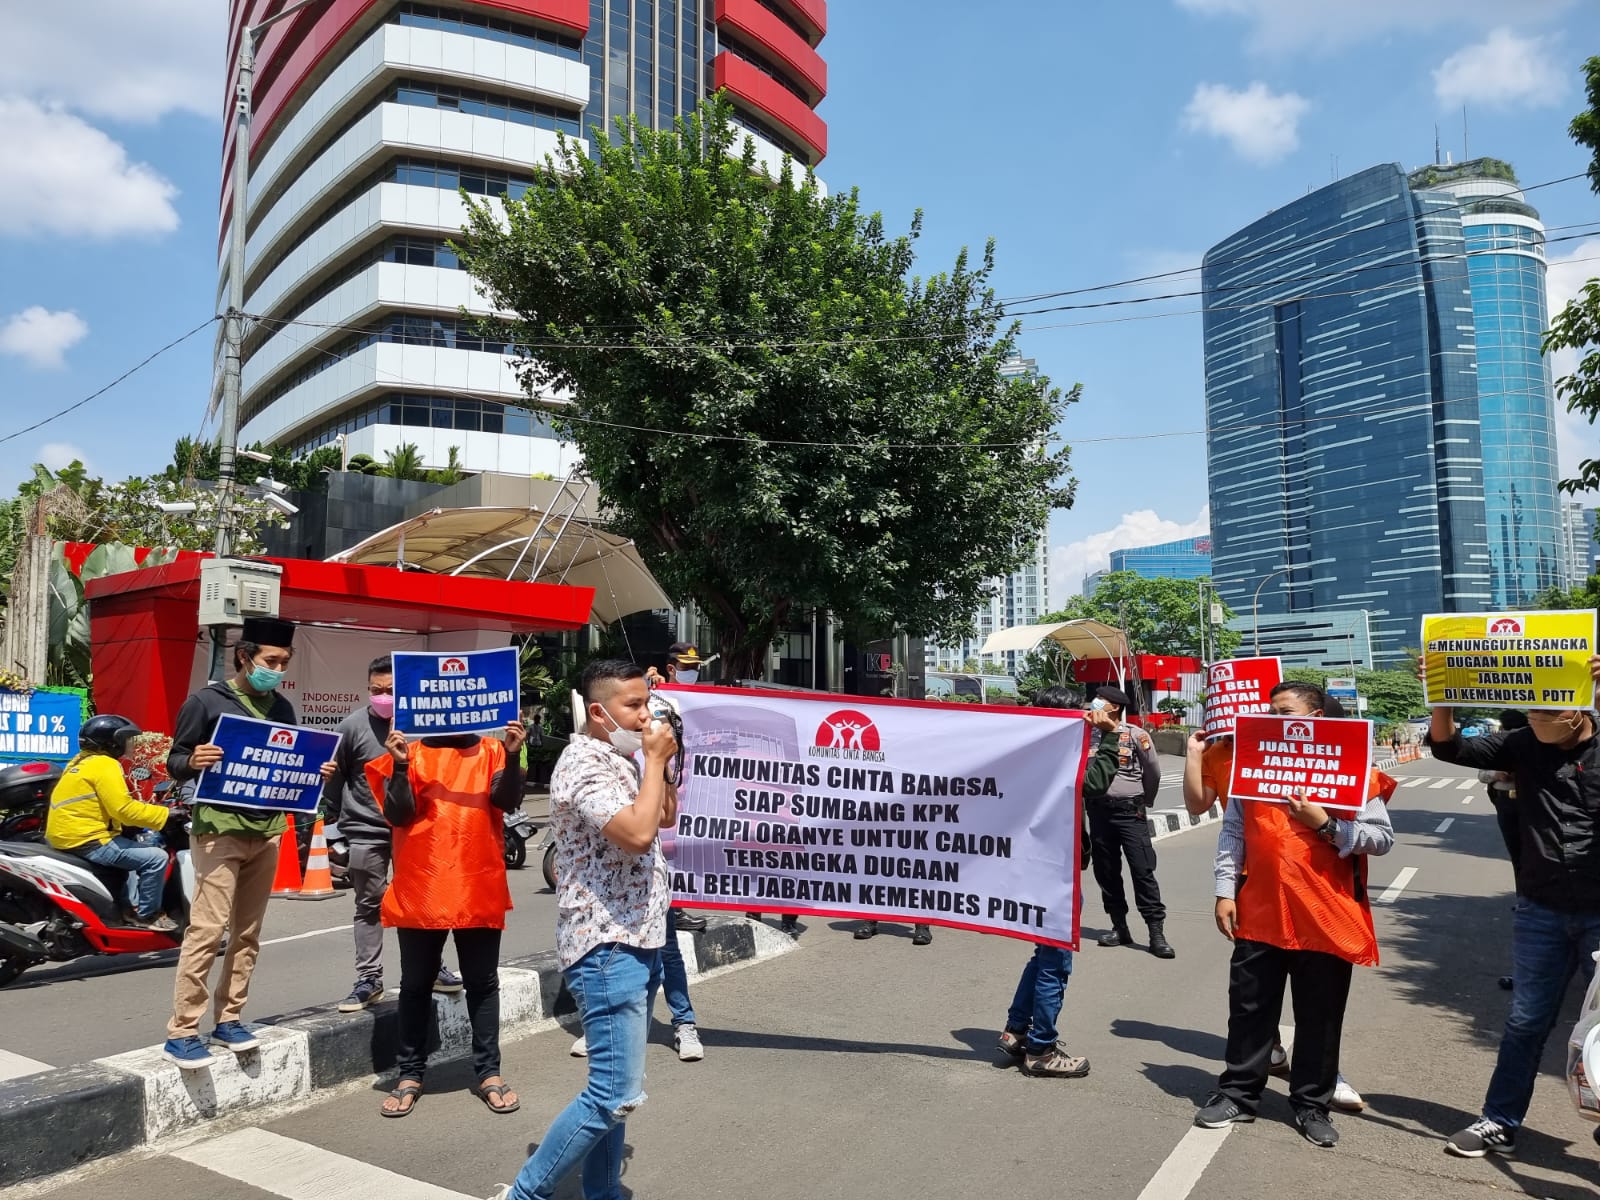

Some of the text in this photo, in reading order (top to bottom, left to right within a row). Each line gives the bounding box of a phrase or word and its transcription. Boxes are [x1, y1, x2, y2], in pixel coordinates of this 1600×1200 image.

[1428, 638, 1588, 651] #MENUNGGUTERSANGKA
[866, 653, 892, 671] KP
[1446, 655, 1563, 668] DUGAAN JUAL BELI
[419, 677, 487, 692] PERIKSA
[1478, 672, 1533, 684] JABATAN
[1207, 684, 1222, 695] AL
[1225, 679, 1259, 691] BELI
[1444, 688, 1575, 702] DI KEMENDESA PDTT
[302, 693, 360, 702] INDONESIA
[398, 690, 514, 709] A IMAN SYUKRI
[1206, 692, 1260, 708] ABATAN
[302, 705, 351, 713] TANGGUH
[1206, 703, 1271, 719] GIAN DAR
[301, 716, 344, 725] INDONE
[414, 708, 499, 727] KPK HEBAT
[0, 733, 69, 754] AN BIMBANG
[1258, 741, 1341, 756] JUAL BELI
[241, 746, 305, 767] PERIKSA
[808, 746, 885, 762] KOMUNITAS CINTA BANGSA
[1262, 755, 1339, 771] JABATAN
[210, 761, 321, 786] A IMAN SYUKRI
[693, 755, 1004, 799] KOMUNITAS CINTA BANGSA,
[1241, 767, 1357, 787] BAGIAN DARI
[222, 780, 303, 801] KPK HEBAT
[734, 789, 960, 823] SIAP SUMBANG KPK
[678, 815, 1011, 858] ROMPI ORANYE UNTUK CALON
[724, 848, 959, 883] TERSANGKA DUGAAN
[704, 874, 749, 897] BELI
[756, 876, 851, 903] JABATAN
[859, 884, 980, 916] KEMENDES
[988, 896, 1047, 928] PDTT
